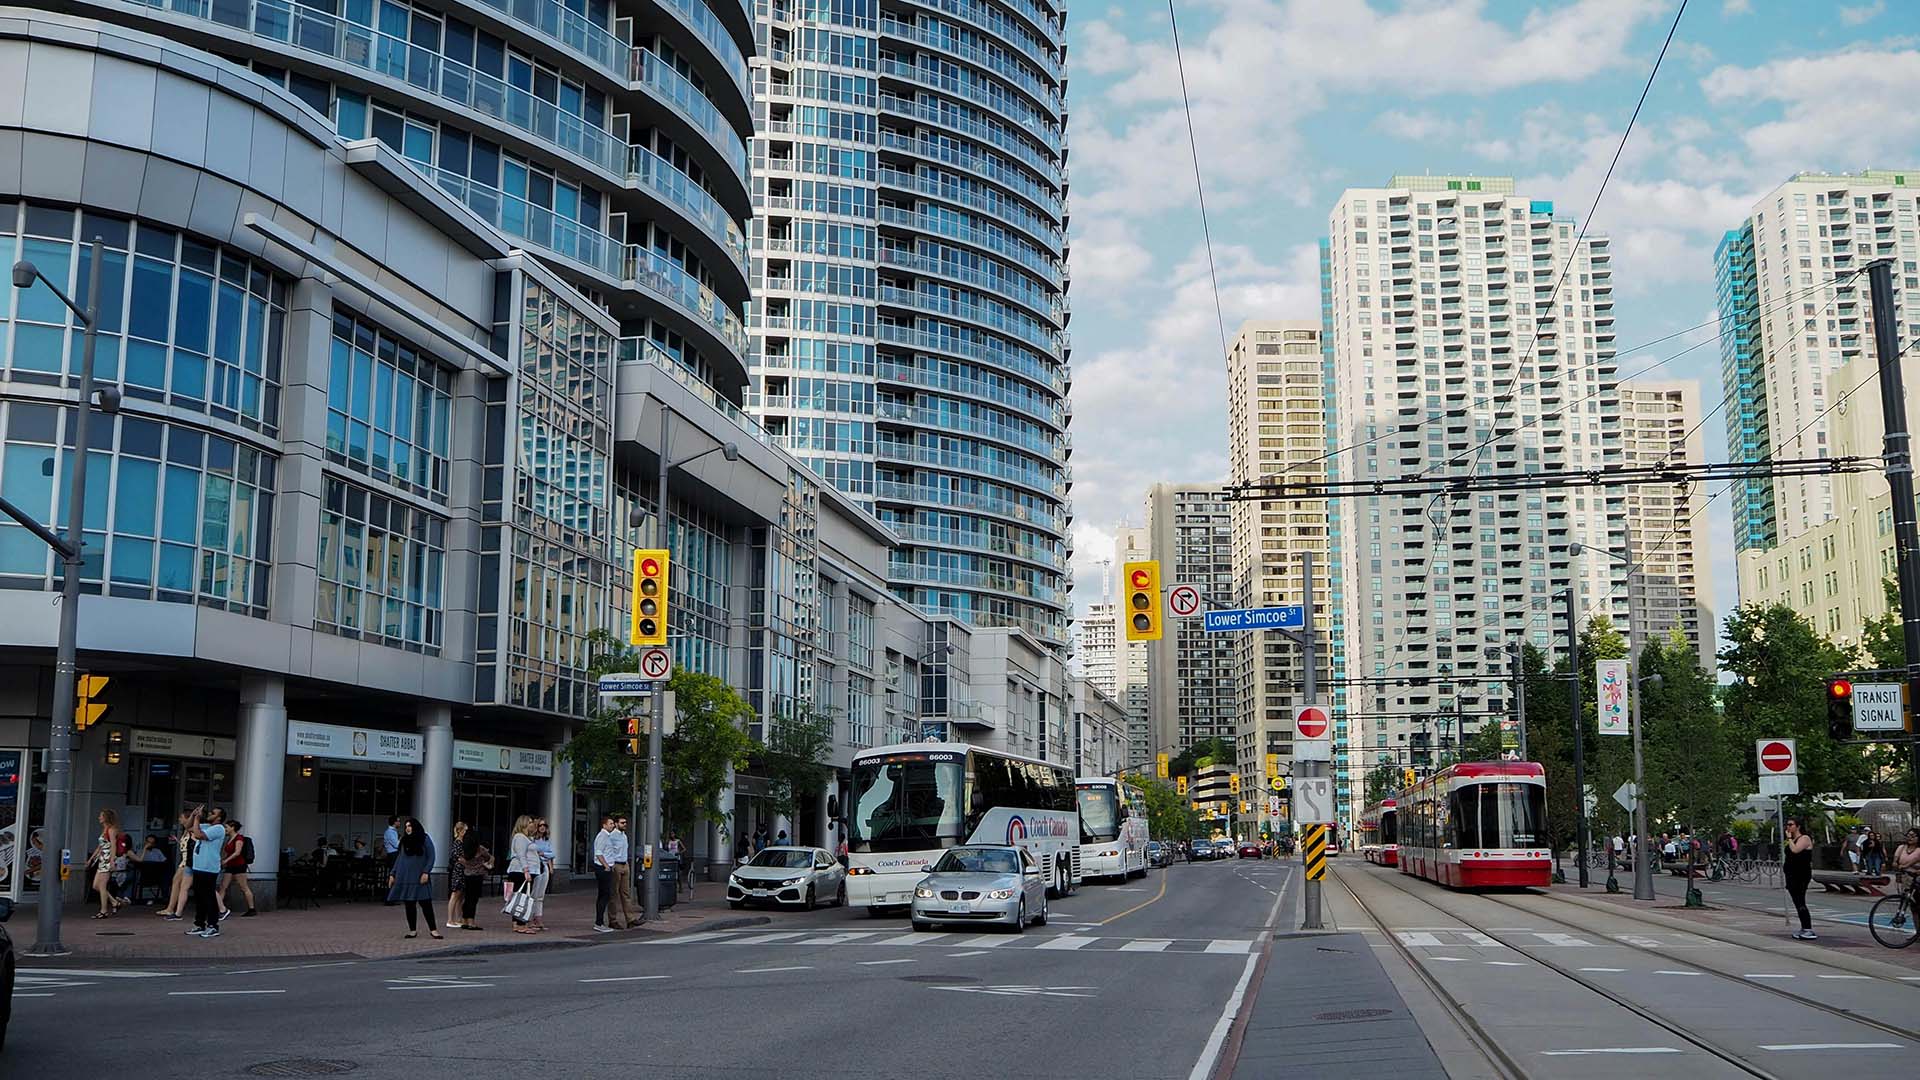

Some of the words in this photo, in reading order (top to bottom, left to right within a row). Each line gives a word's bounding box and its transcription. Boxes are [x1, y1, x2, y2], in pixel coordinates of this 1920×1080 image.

[1208, 613, 1242, 627] Lower
[1244, 610, 1287, 625] Simcoe
[1289, 608, 1297, 616] St
[601, 682, 619, 690] Lower
[620, 682, 643, 690] Simcoe
[1857, 691, 1897, 704] TRANSIT
[1860, 709, 1897, 722] SIGNAL
[379, 735, 400, 750] SHATTER
[400, 736, 417, 751] ABBAS
[858, 758, 881, 766] 86003
[1030, 816, 1048, 837] Coach
[1049, 816, 1068, 837] Canada
